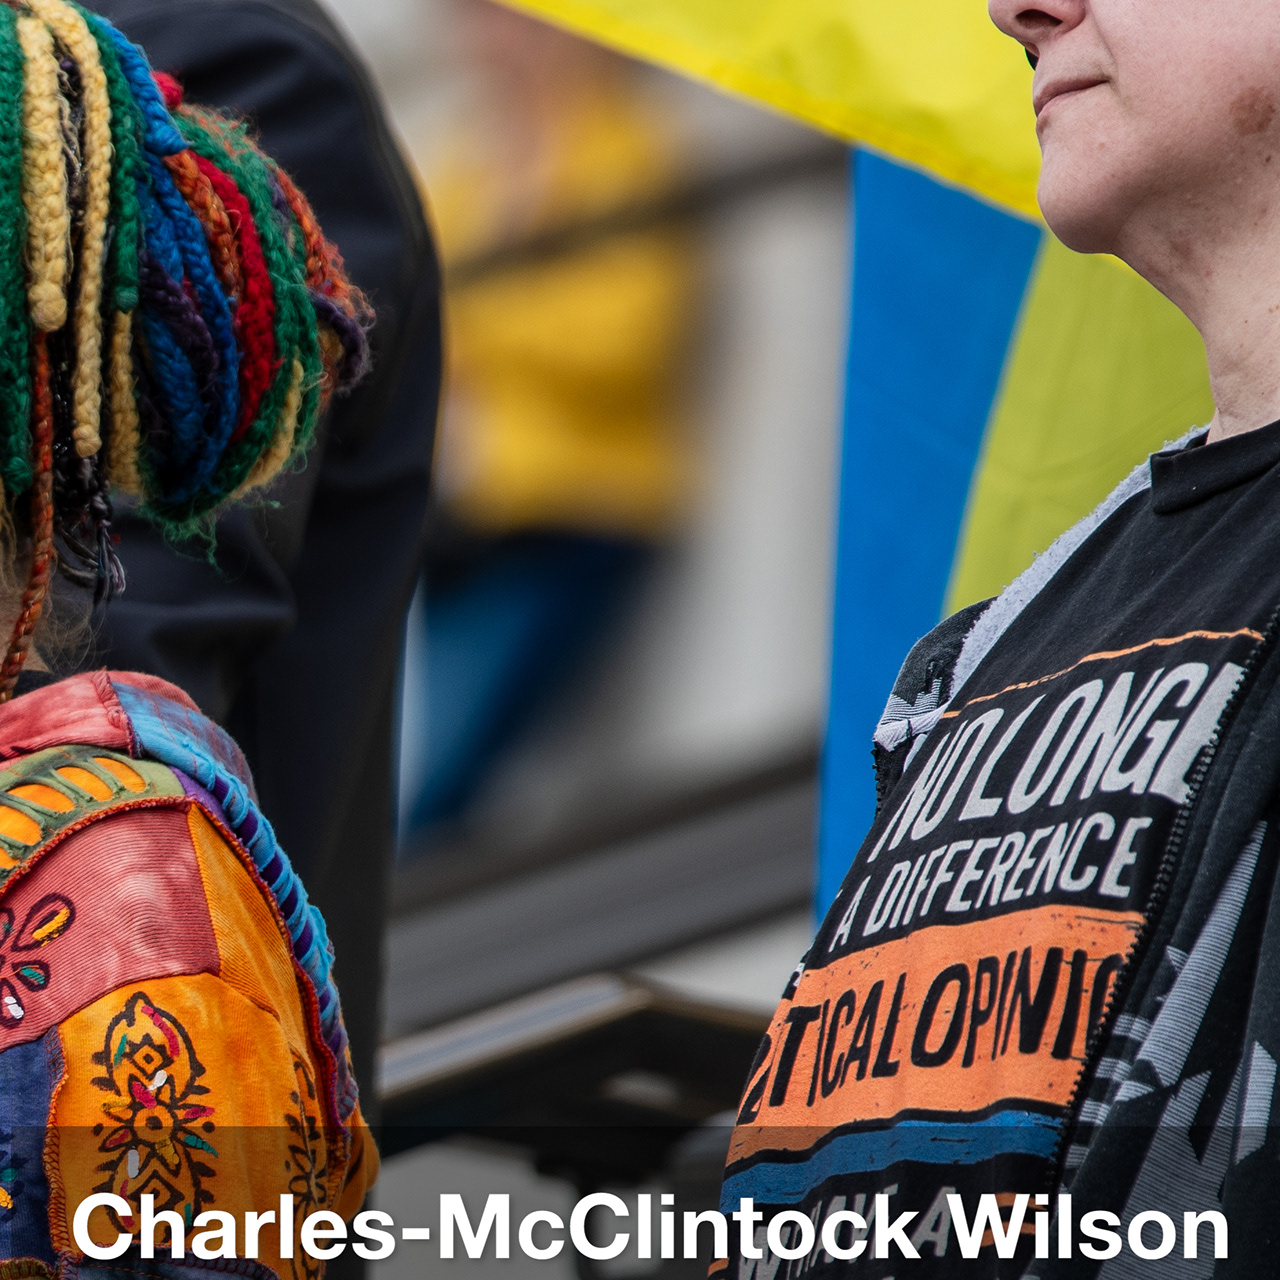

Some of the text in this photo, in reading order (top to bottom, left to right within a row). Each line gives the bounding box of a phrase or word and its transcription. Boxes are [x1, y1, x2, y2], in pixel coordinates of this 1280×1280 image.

[867, 708, 1005, 864] NO
[828, 812, 1153, 953] A DIFFERENCE
